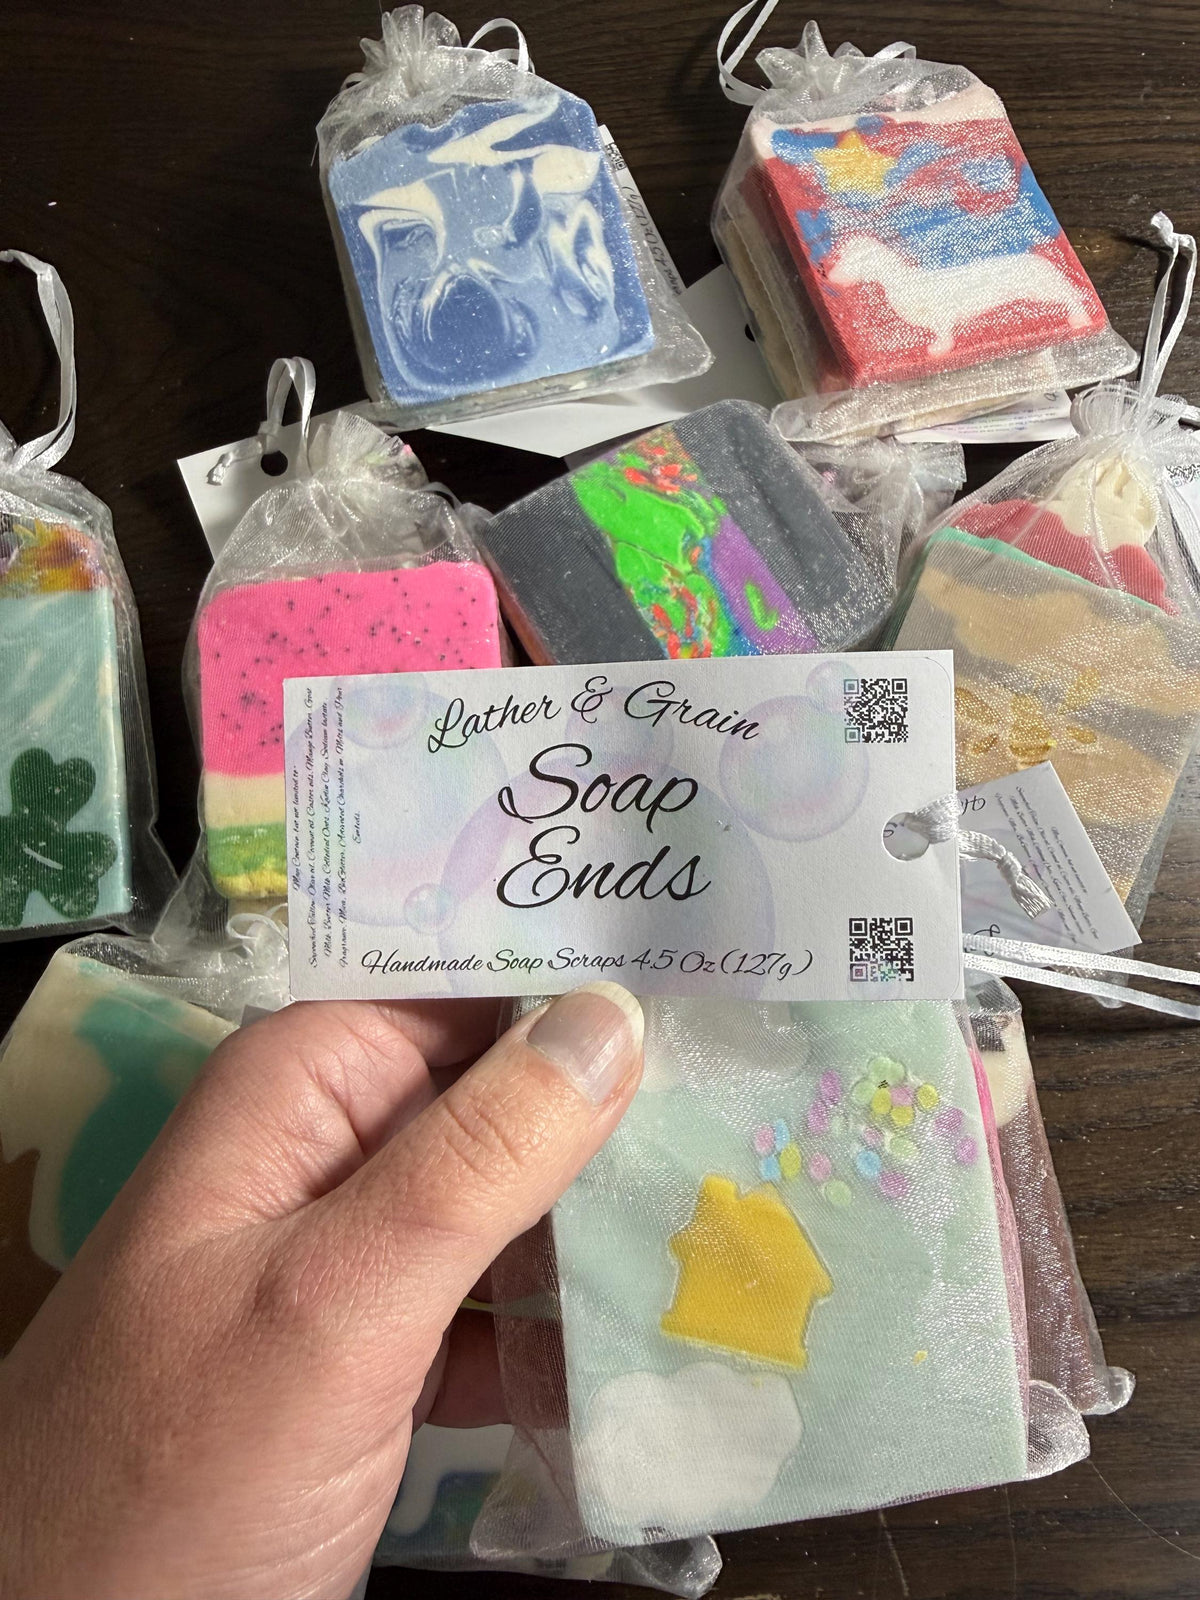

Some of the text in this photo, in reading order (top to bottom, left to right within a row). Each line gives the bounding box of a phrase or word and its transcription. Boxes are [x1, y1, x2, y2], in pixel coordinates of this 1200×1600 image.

[428, 675, 760, 753] Lather & Grain
[497, 743, 699, 834] Soap
[496, 825, 712, 908] Ends
[361, 947, 813, 980] Handmade Soap Scraps 4.5 Oz (127g)
